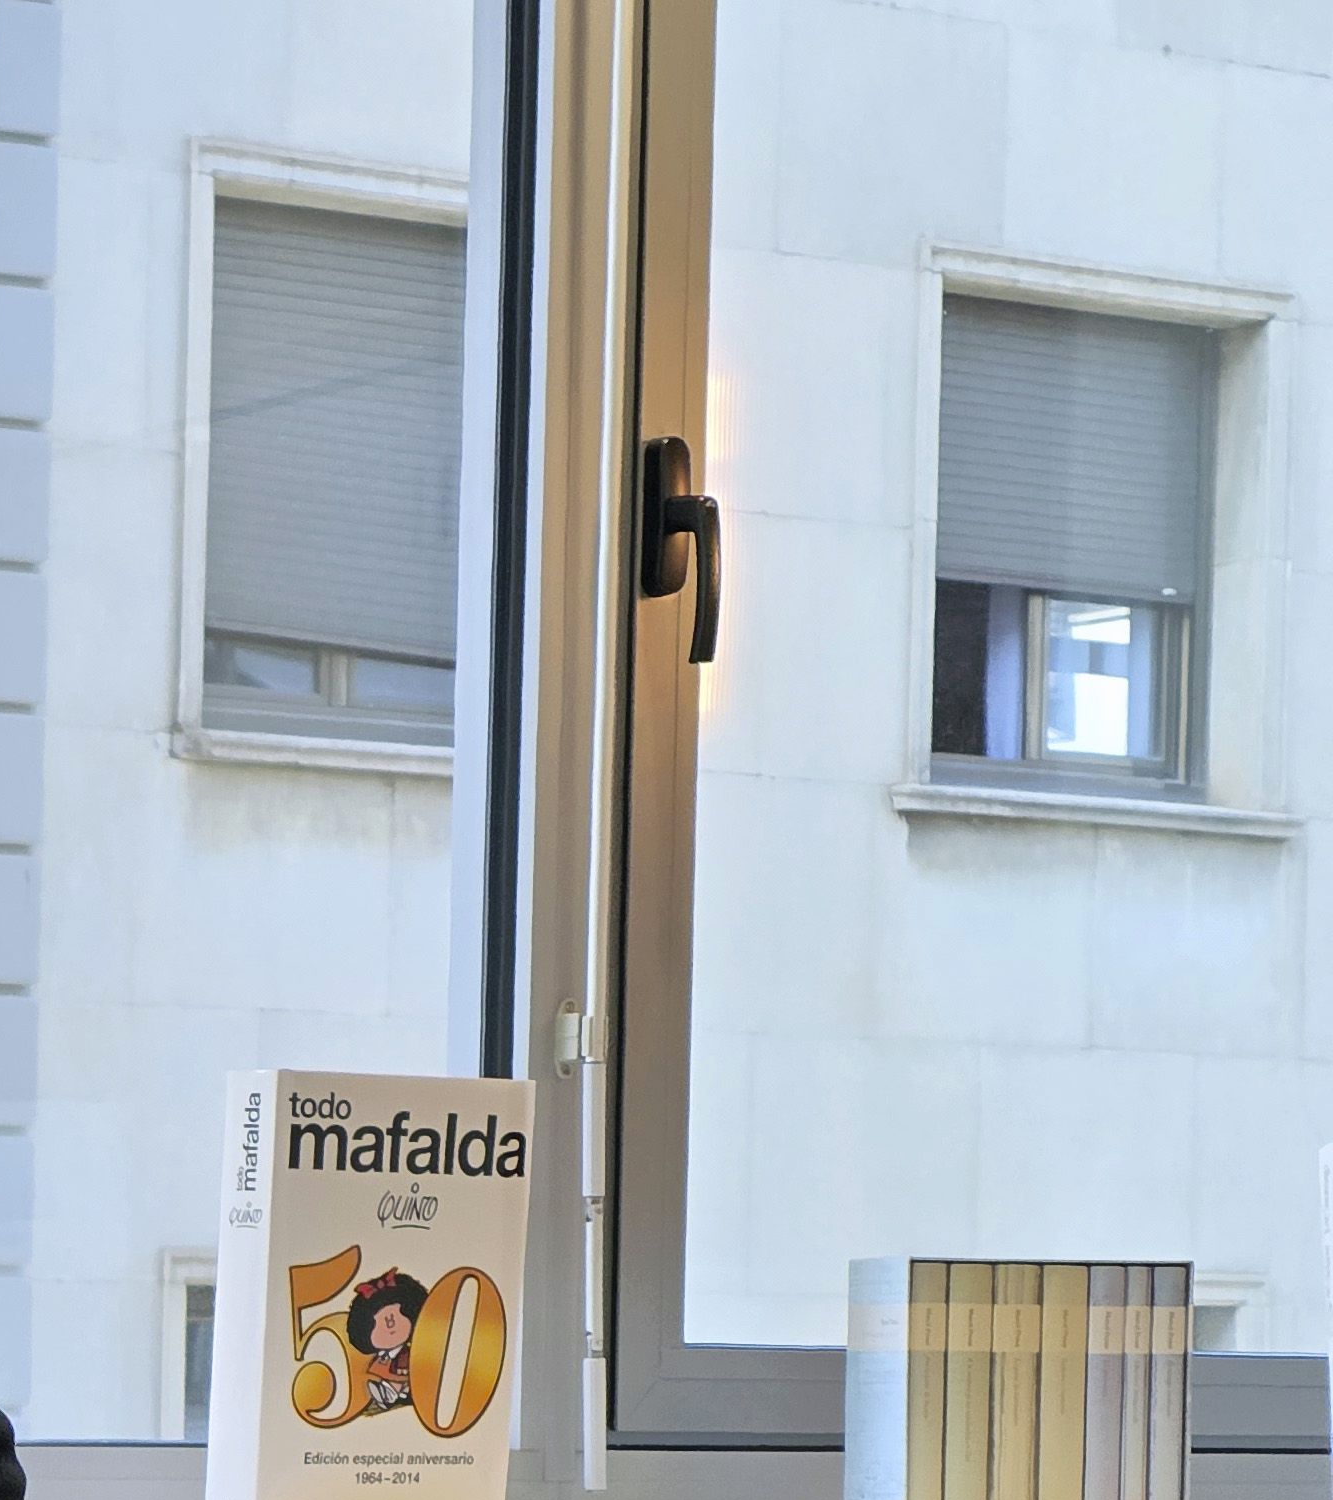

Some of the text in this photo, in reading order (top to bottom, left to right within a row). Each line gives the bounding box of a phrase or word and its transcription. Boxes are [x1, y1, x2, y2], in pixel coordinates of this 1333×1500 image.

[289, 1092, 351, 1120] todo
[243, 1091, 262, 1192] mafalda
[289, 1111, 526, 1178] mafalda
[289, 1245, 507, 1438] 50
[303, 1450, 475, 1468] Edición especial aniversario
[354, 1470, 421, 1486] 1964-2014
